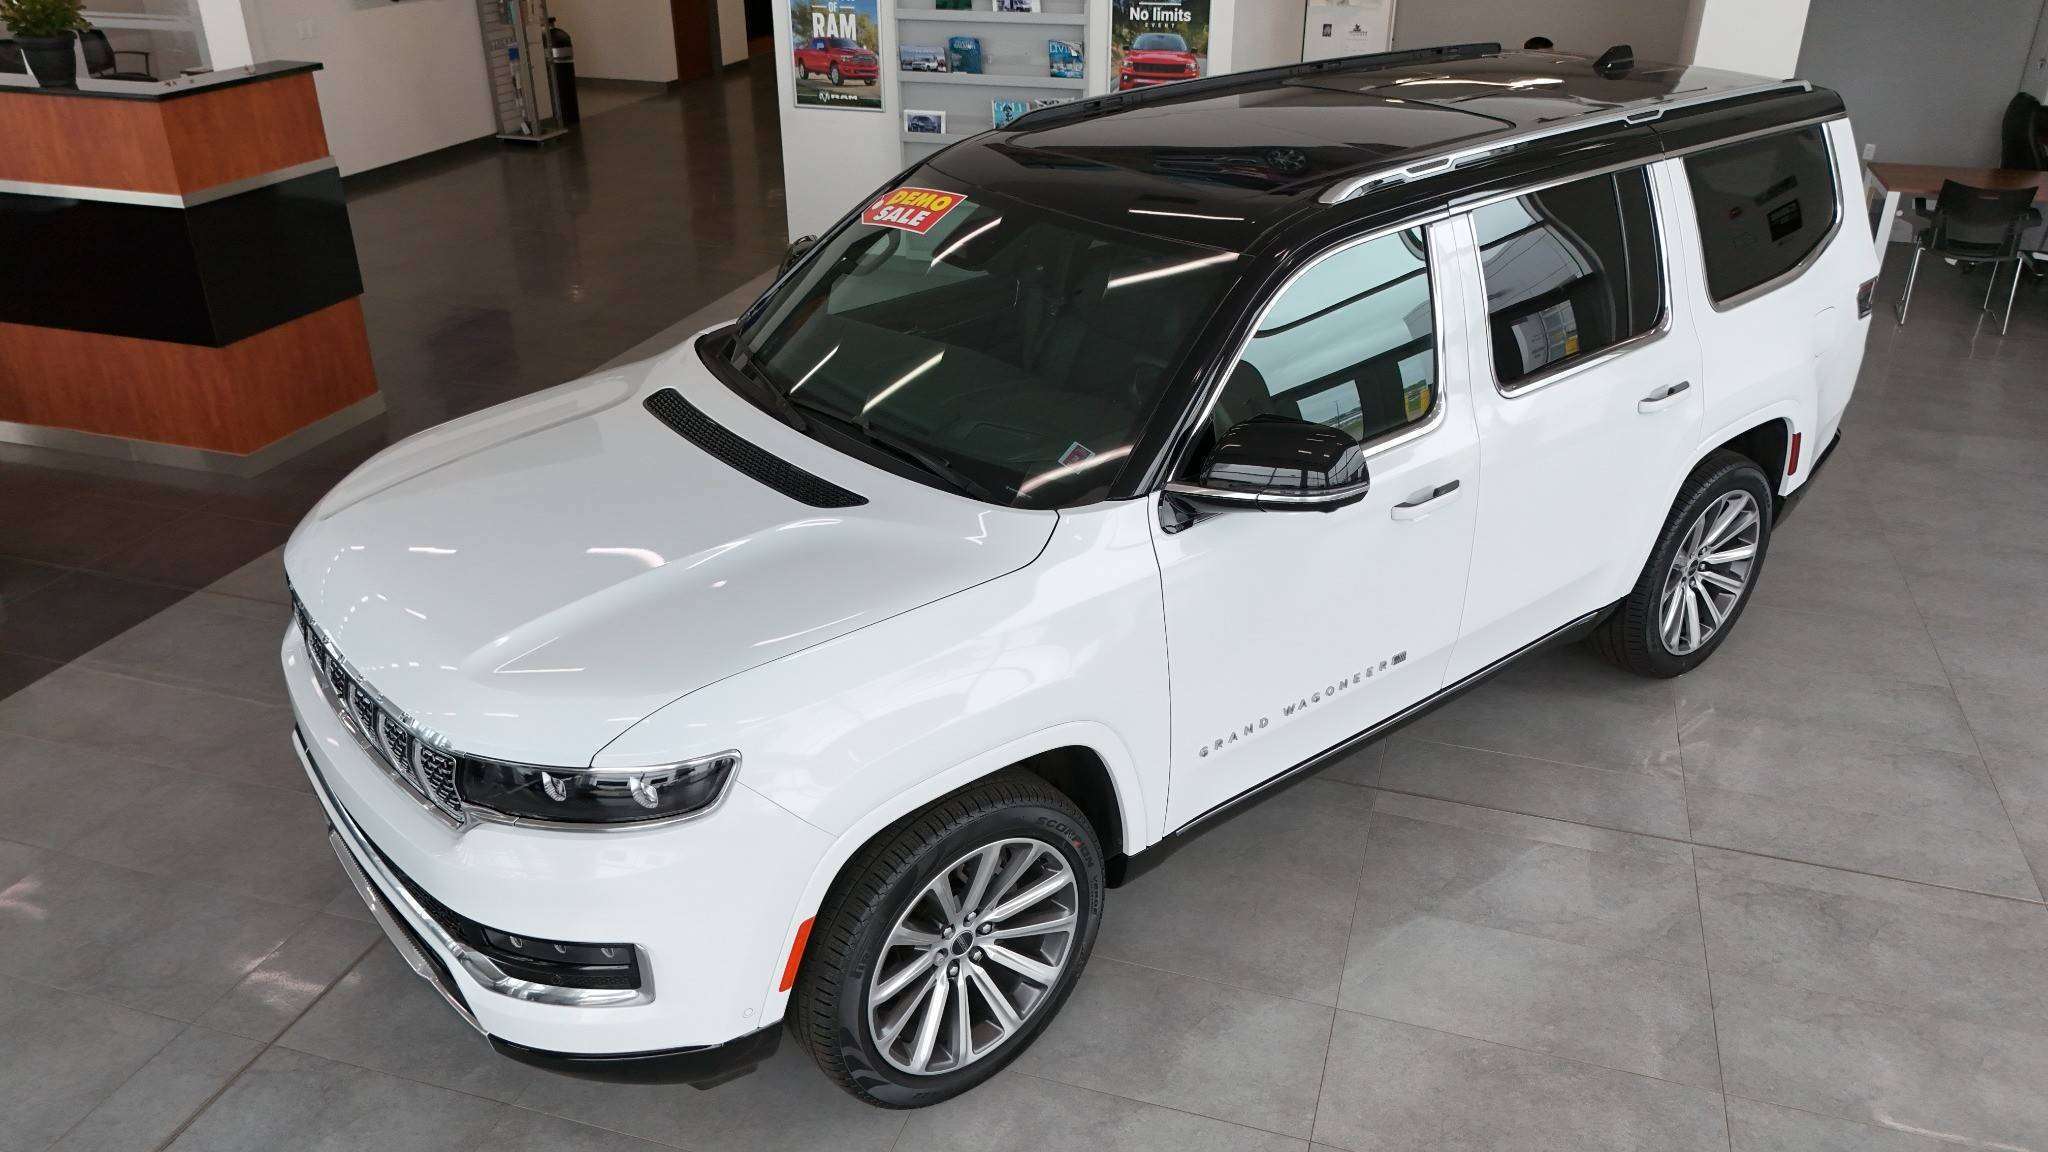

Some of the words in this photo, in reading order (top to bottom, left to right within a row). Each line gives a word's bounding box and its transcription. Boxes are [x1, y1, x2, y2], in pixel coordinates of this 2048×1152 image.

[828, 2, 837, 12] OF
[1129, 7, 1149, 21] No
[1152, 7, 1192, 22] limits
[812, 13, 857, 40] RAM
[886, 190, 953, 212] DEMO
[873, 205, 931, 227] SALE
[1199, 717, 1269, 758] GRAND
[1283, 660, 1387, 716] WAGONEER
